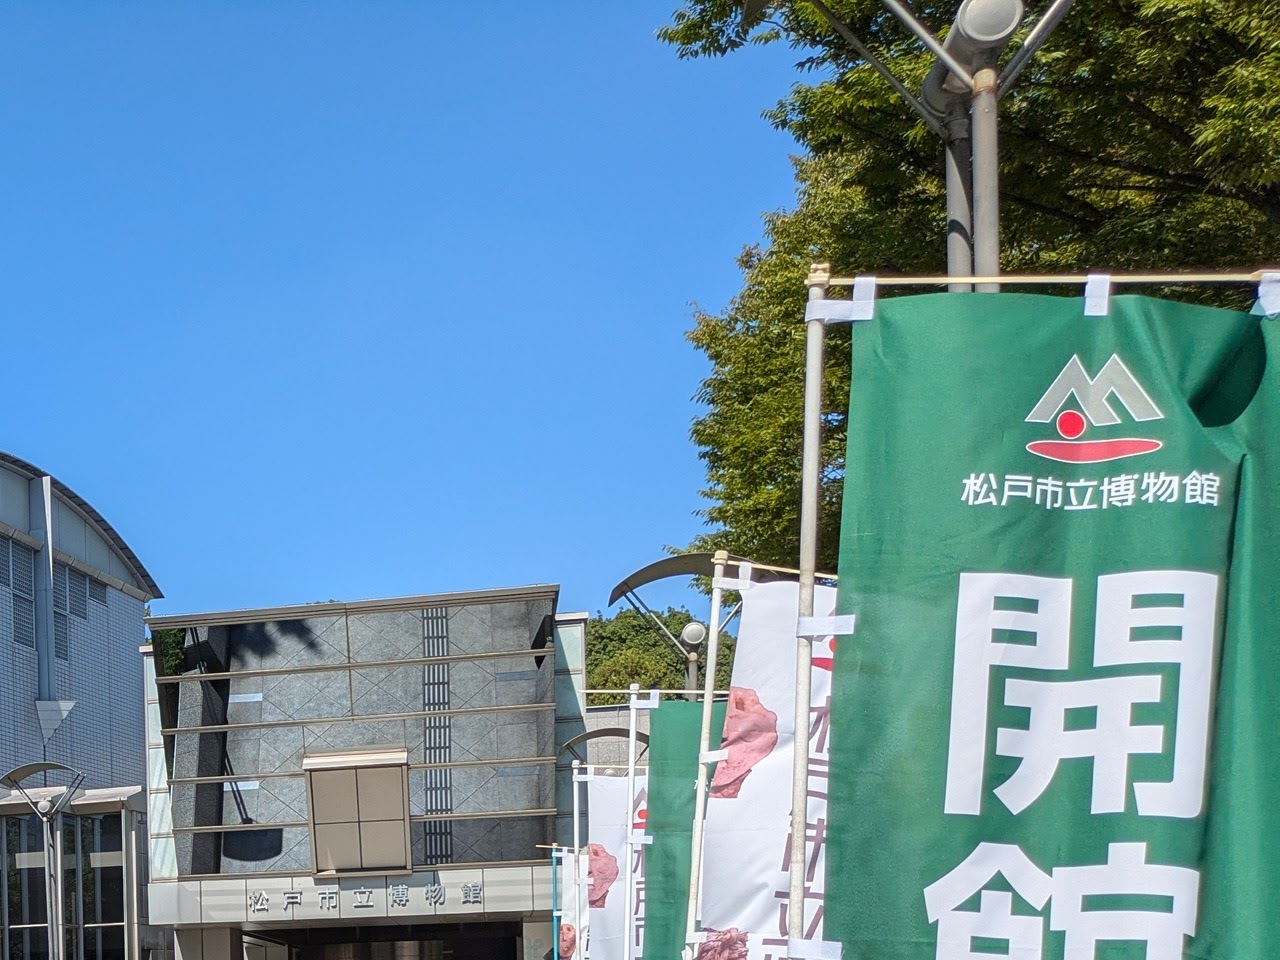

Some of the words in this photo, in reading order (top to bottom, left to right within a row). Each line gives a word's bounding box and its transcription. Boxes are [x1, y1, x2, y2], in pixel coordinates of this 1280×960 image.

[960, 469, 1221, 511] 松戸市立博物館
[248, 881, 483, 913] 松戸市立博物館
